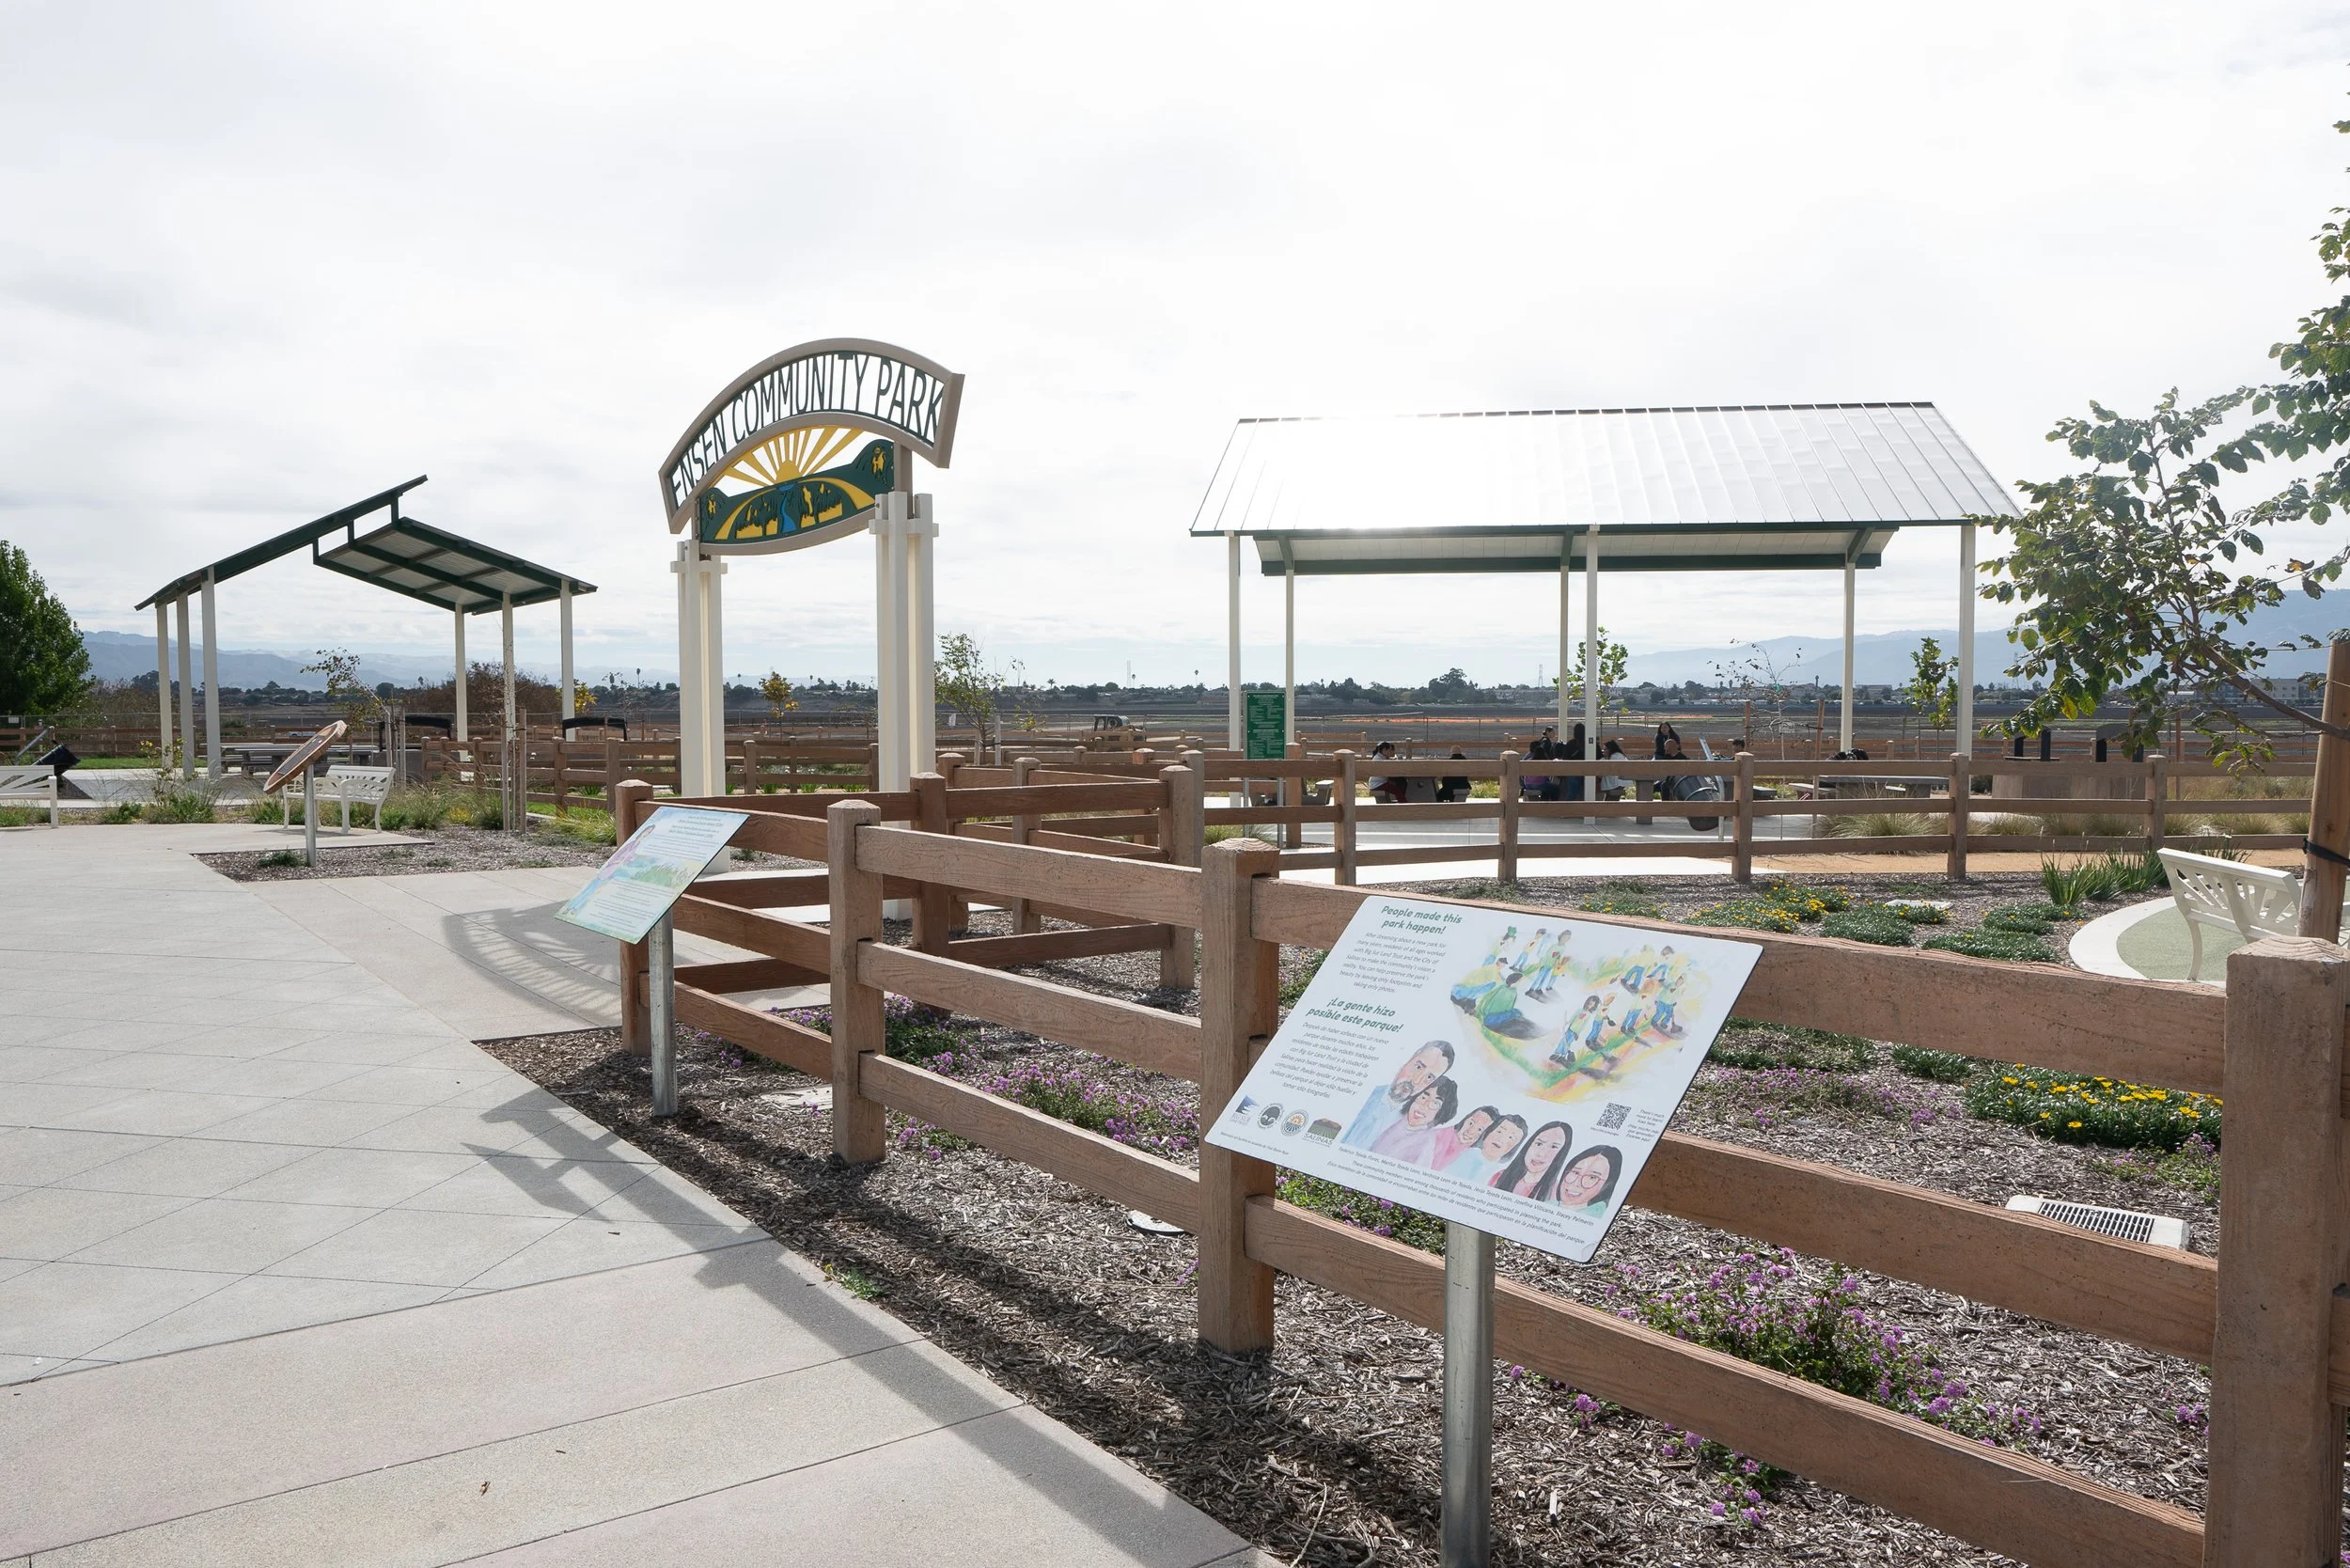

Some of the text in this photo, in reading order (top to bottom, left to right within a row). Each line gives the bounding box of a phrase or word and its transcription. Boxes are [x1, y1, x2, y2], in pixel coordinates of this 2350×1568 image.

[671, 353, 944, 510] ENSEN COMMUNITY PARK
[1381, 906, 1463, 923] People made this
[1381, 920, 1447, 933] park happen!
[1326, 997, 1395, 1016] ¡La gente hizo
[1306, 1009, 1403, 1032] posible este parque!
